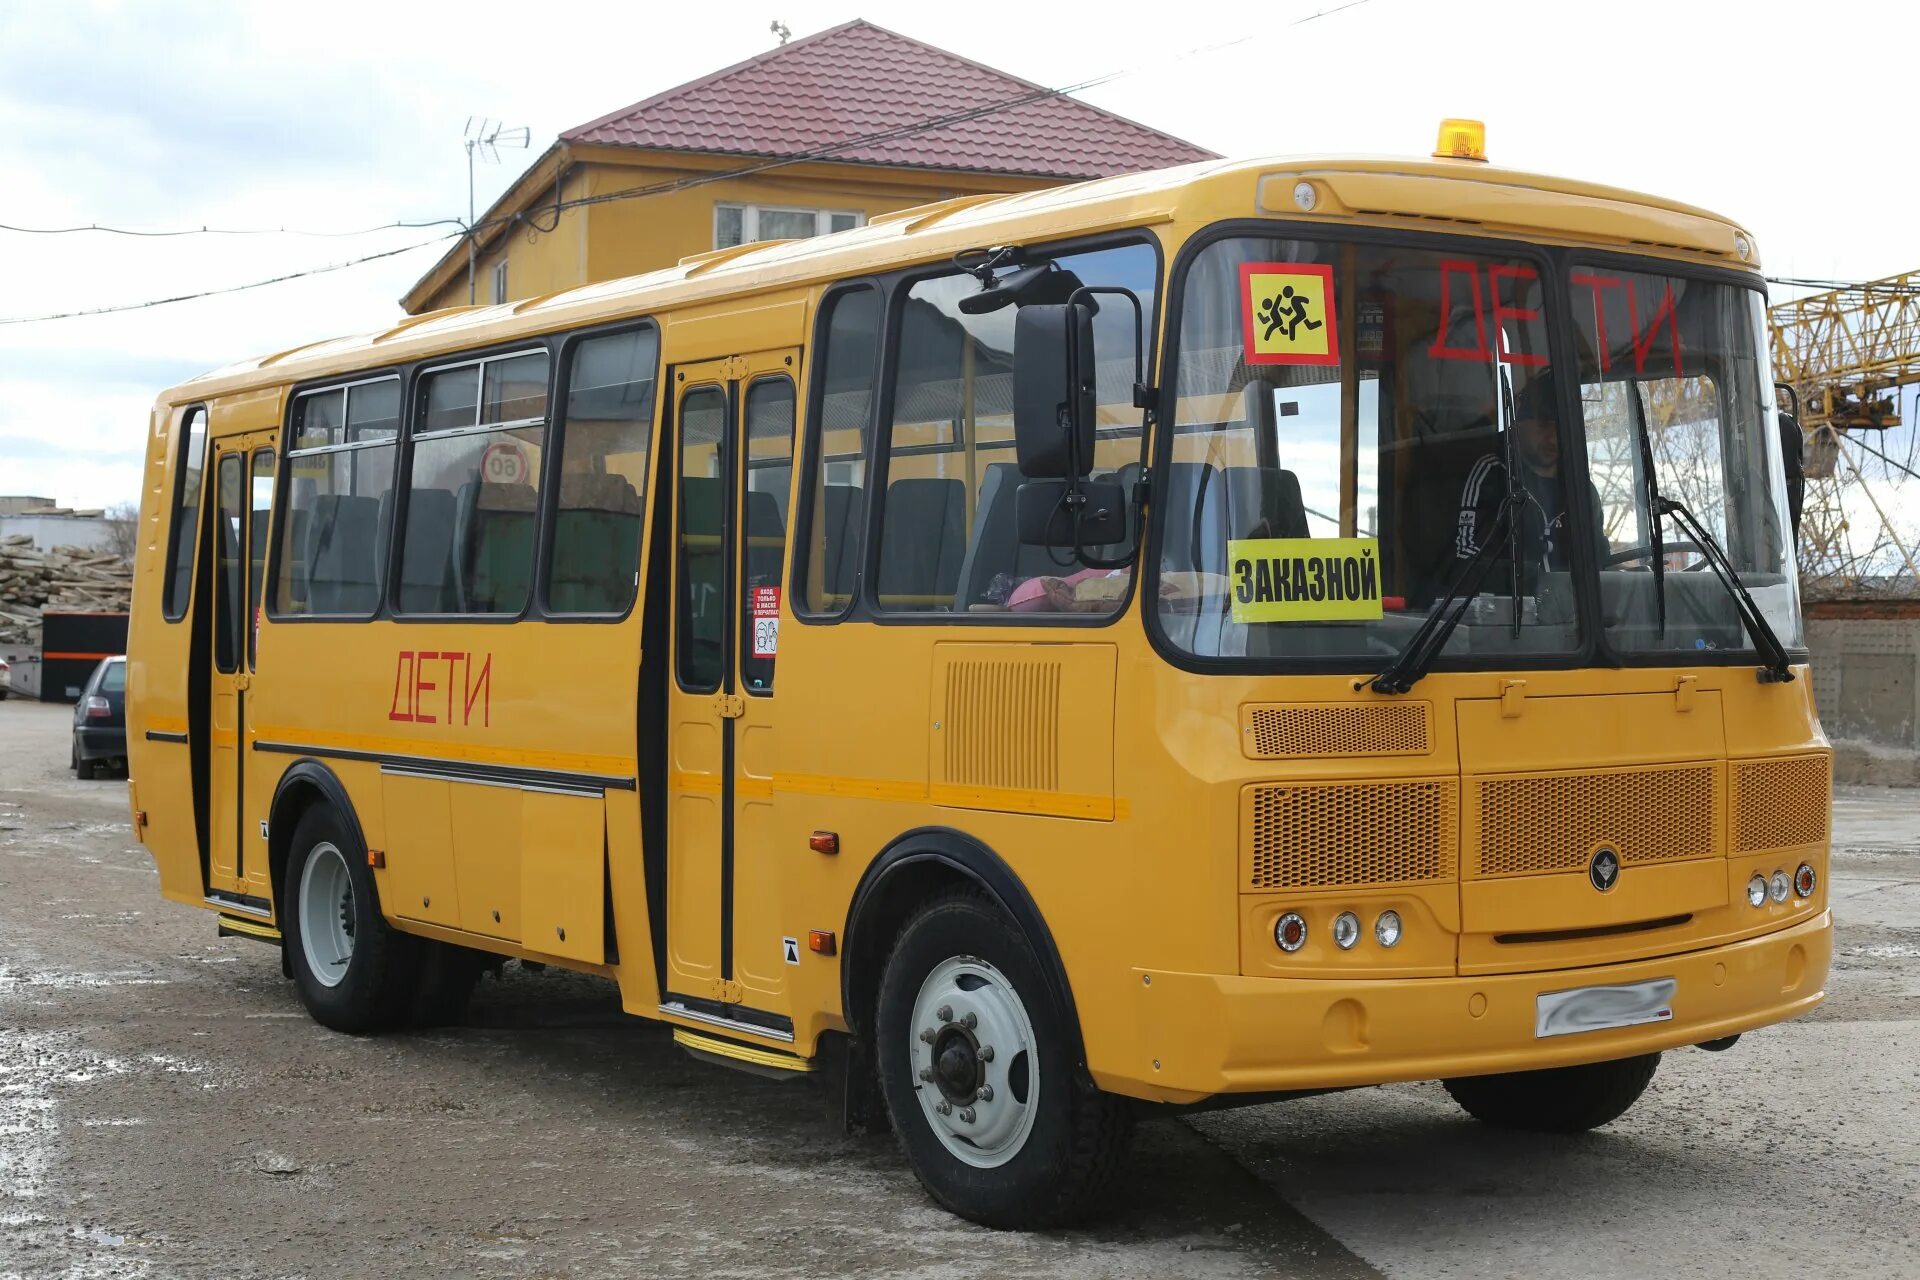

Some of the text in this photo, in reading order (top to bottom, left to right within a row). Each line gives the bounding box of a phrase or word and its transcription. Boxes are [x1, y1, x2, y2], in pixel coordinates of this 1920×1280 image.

[1427, 259, 1683, 378] ДЕТИ
[1235, 549, 1377, 604] ЗАКАЗНОЙ
[389, 651, 492, 728] ДЕТИ
